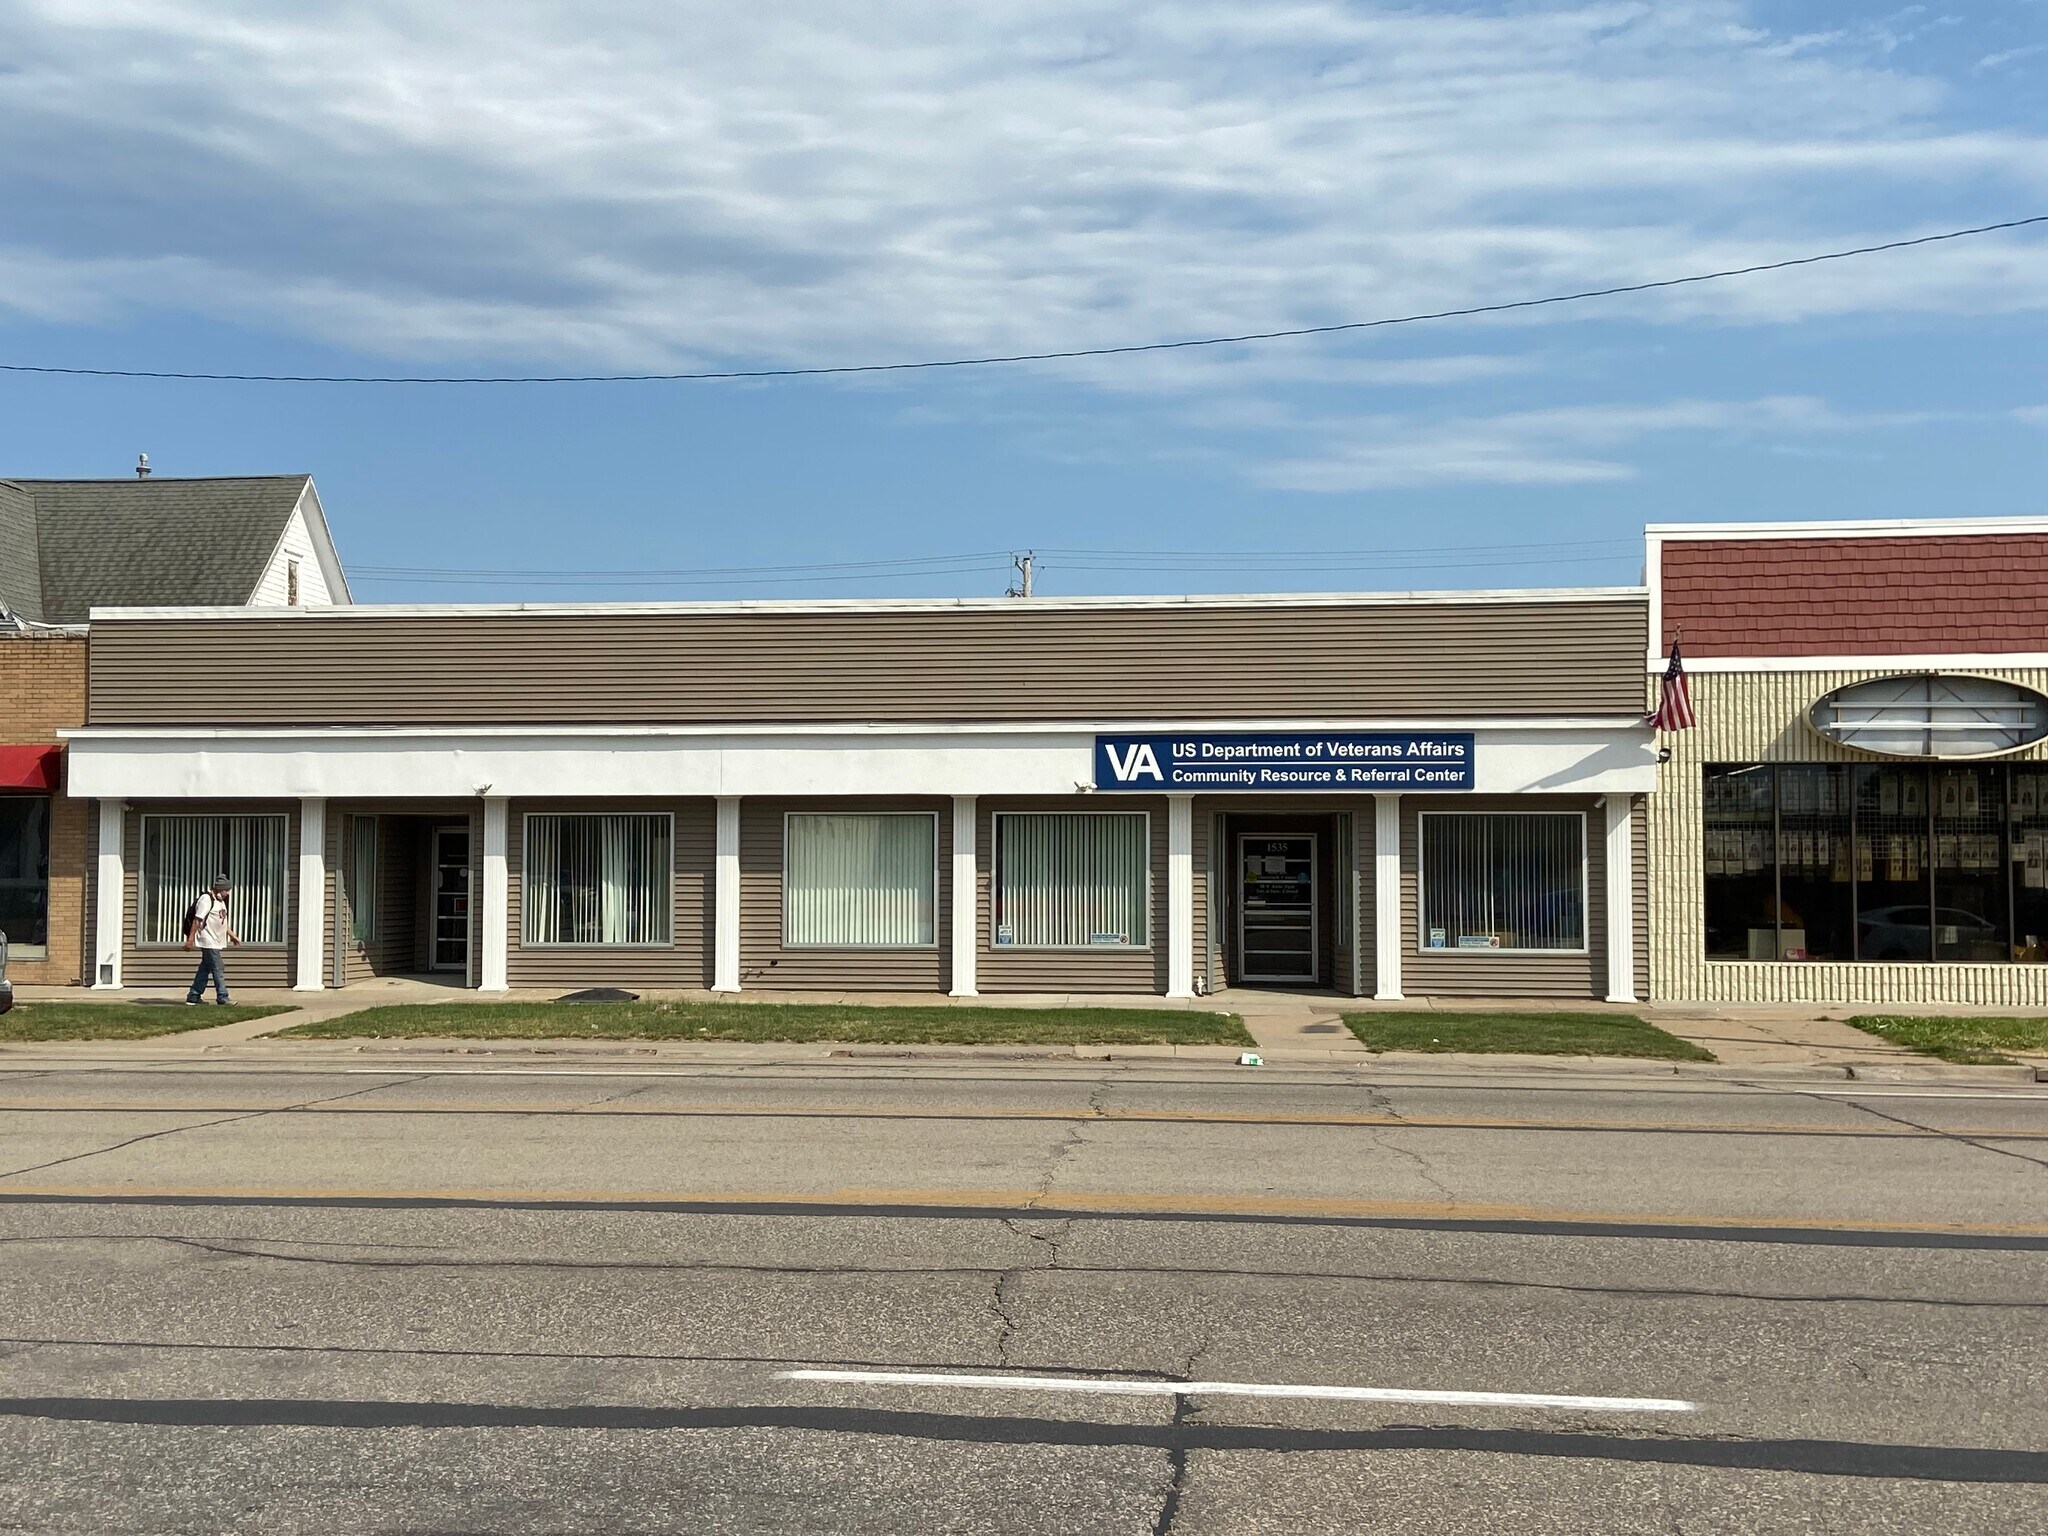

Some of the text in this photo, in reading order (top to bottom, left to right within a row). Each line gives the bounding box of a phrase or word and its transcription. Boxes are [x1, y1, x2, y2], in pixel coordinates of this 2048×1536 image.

[1172, 741, 1465, 760] US Department of Veterans Affairs
[1105, 744, 1164, 781] VA
[1172, 768, 1465, 785] Community Resource & Referral Center
[1267, 842, 1288, 852] 1535
